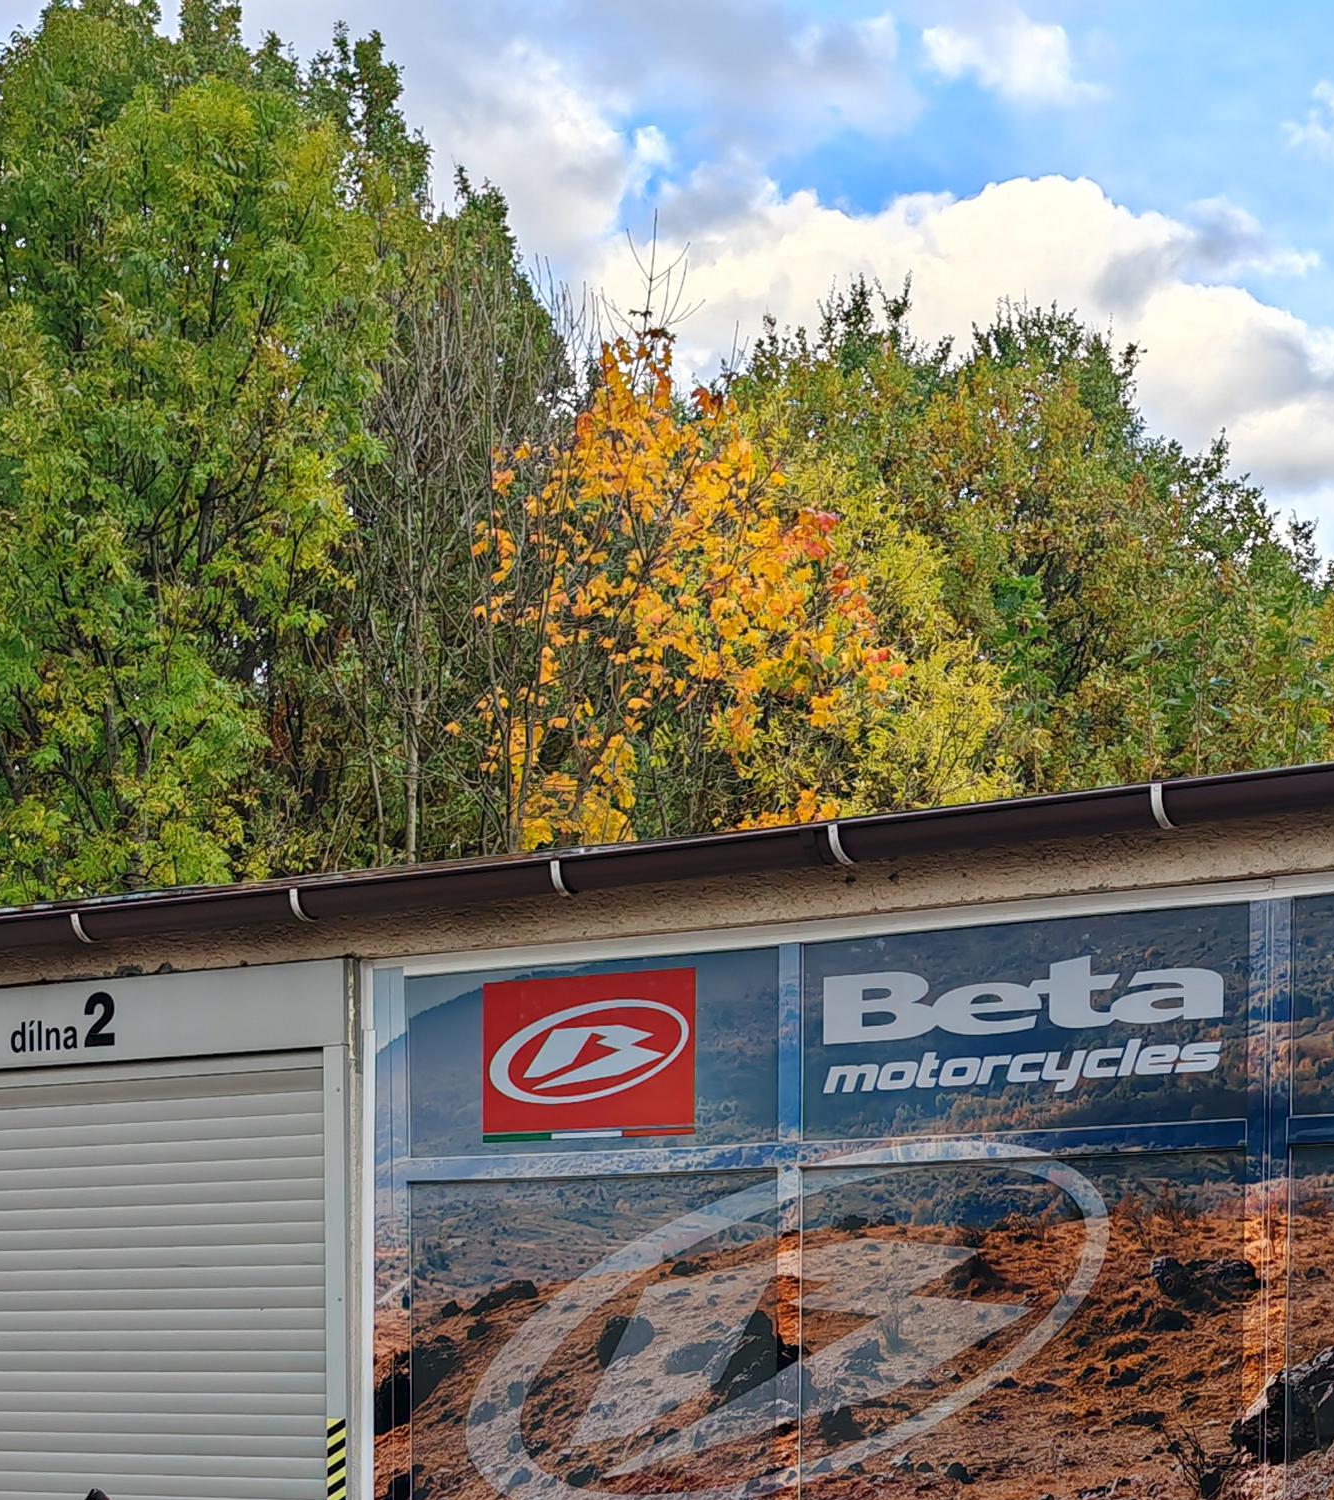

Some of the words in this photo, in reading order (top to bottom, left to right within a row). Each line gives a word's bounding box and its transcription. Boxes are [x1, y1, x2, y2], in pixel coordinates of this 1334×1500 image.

[10, 1020, 78, 1053] dílna
[84, 991, 115, 1048] 2
[822, 955, 1225, 1046] Beta
[822, 1038, 1223, 1093] motorcycles
